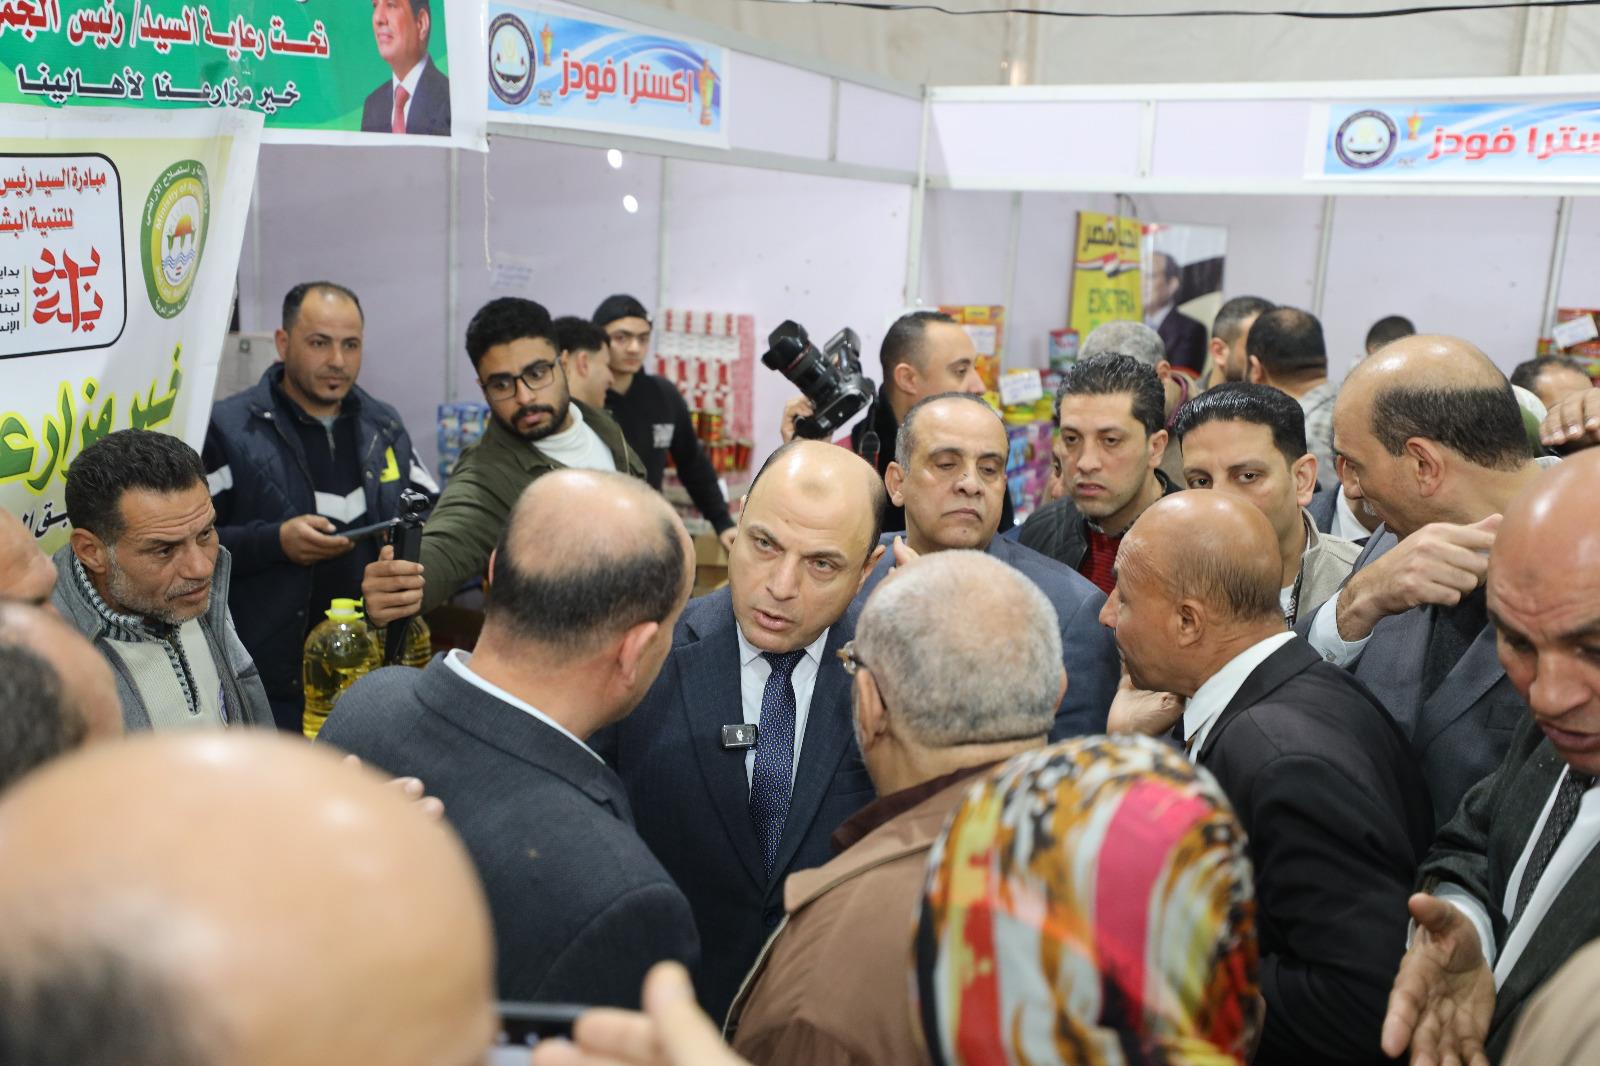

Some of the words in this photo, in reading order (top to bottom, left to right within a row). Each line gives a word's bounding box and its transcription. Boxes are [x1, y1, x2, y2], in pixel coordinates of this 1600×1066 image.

[0, 0, 59, 40] الجم
[69, 0, 124, 47] رئيس
[203, 7, 265, 58] رعاية
[270, 16, 329, 57] تحت
[17, 64, 143, 102] لأهالينا
[154, 71, 251, 106] مزارعنا
[559, 51, 616, 100] فودز
[257, 81, 299, 113] خير
[1427, 127, 1516, 160] فودز
[1528, 126, 1600, 160] سترا
[0, 166, 32, 197] رئيس
[36, 166, 70, 195] السيد
[72, 165, 106, 193] مبادرة
[0, 206, 30, 239] البش
[31, 206, 74, 237] للتنمية
[0, 266, 19, 279] بداي
[0, 287, 19, 298] جدي
[0, 302, 20, 316] لبنا
[0, 379, 113, 491] مزارع
